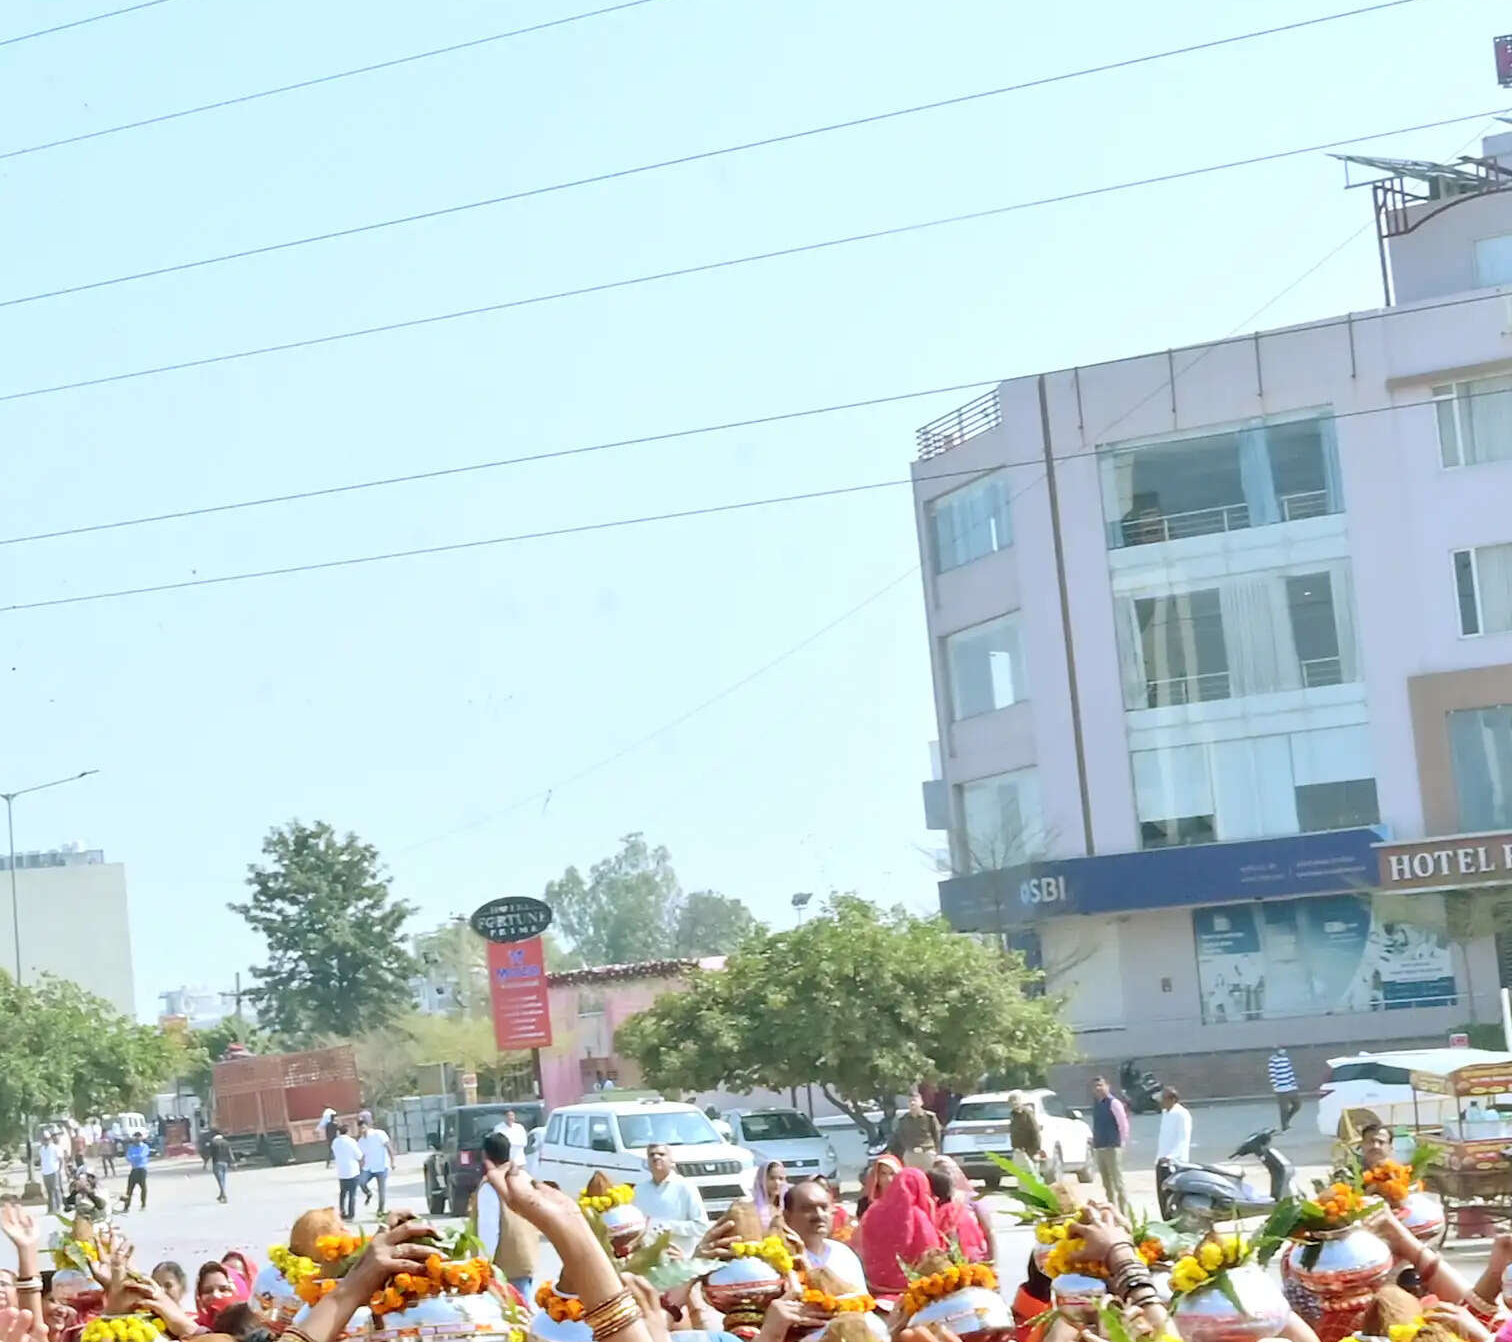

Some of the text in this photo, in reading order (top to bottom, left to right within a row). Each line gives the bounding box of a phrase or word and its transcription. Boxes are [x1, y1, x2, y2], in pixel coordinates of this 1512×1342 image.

[1388, 843, 1495, 882] HOTEL
[1030, 874, 1066, 903] SBI
[478, 911, 547, 929] FORTUNE
